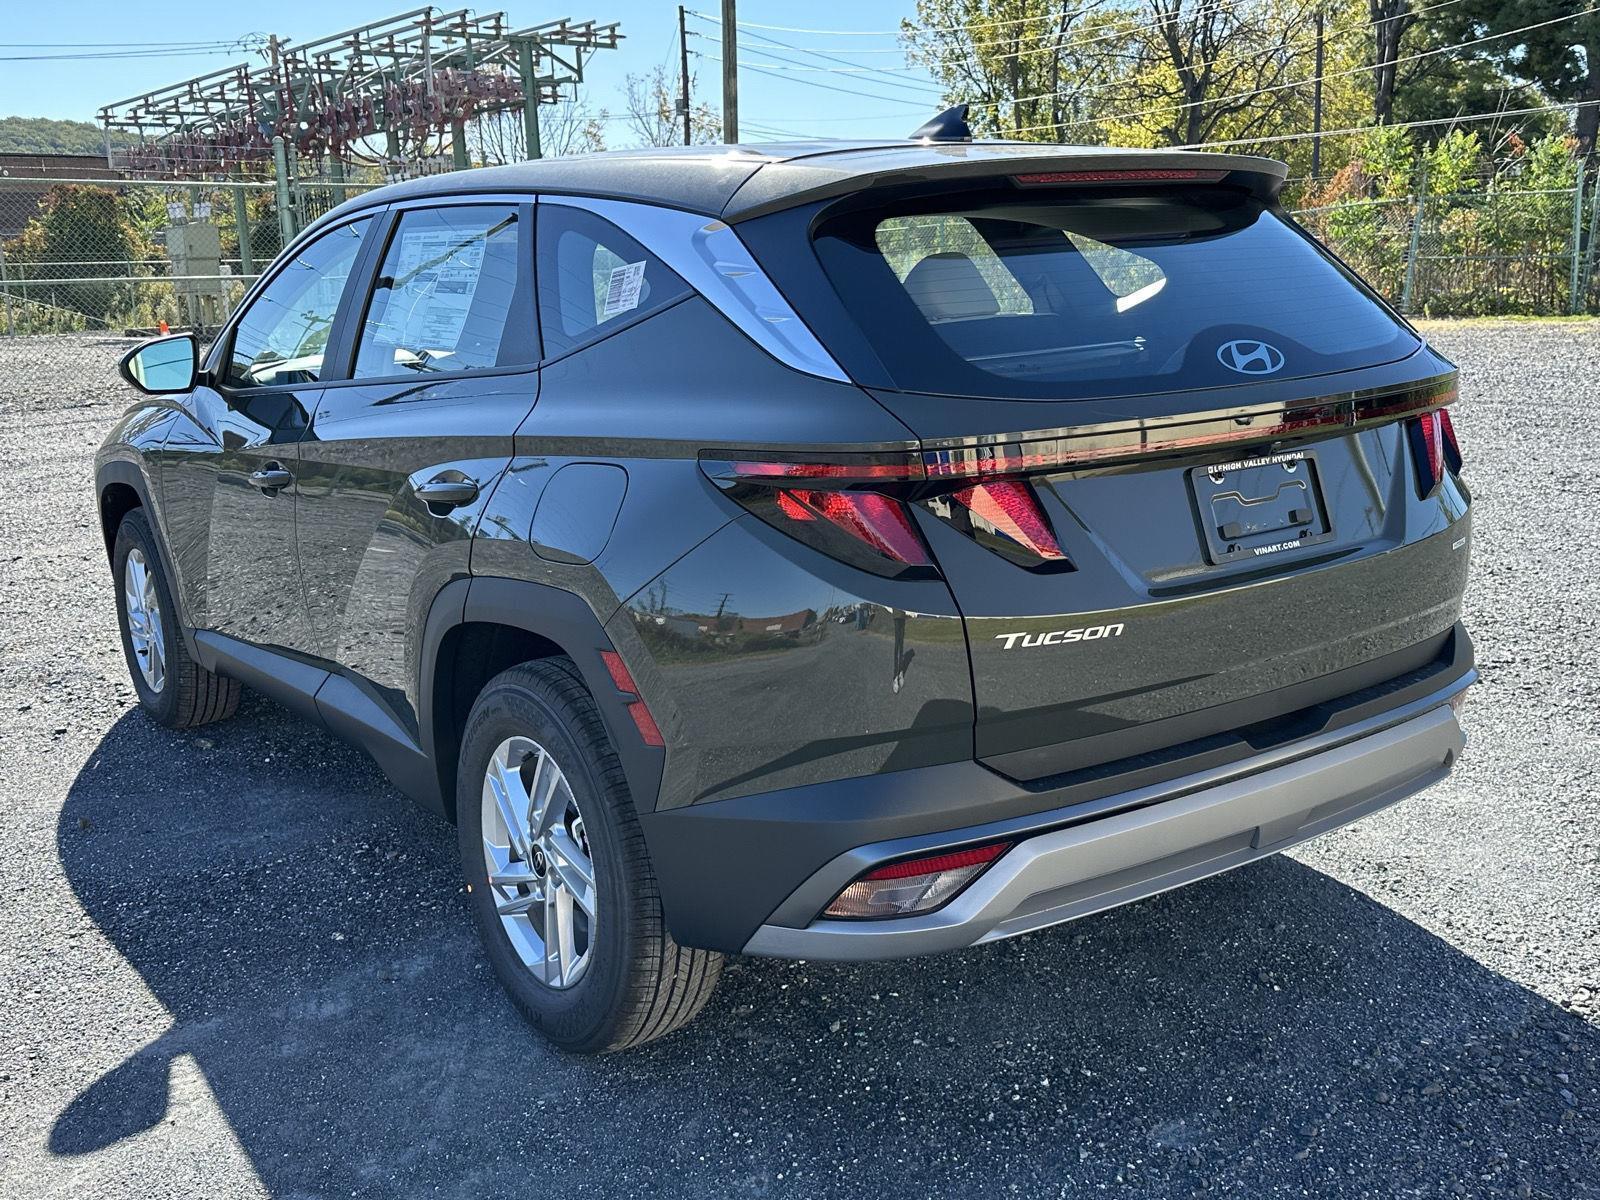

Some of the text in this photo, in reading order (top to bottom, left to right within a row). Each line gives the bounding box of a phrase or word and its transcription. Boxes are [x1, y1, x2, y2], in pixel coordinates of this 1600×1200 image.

[1214, 452, 1304, 473] LEHIGH VALLEY HYUNDAI
[1253, 540, 1300, 556] VINART.COM
